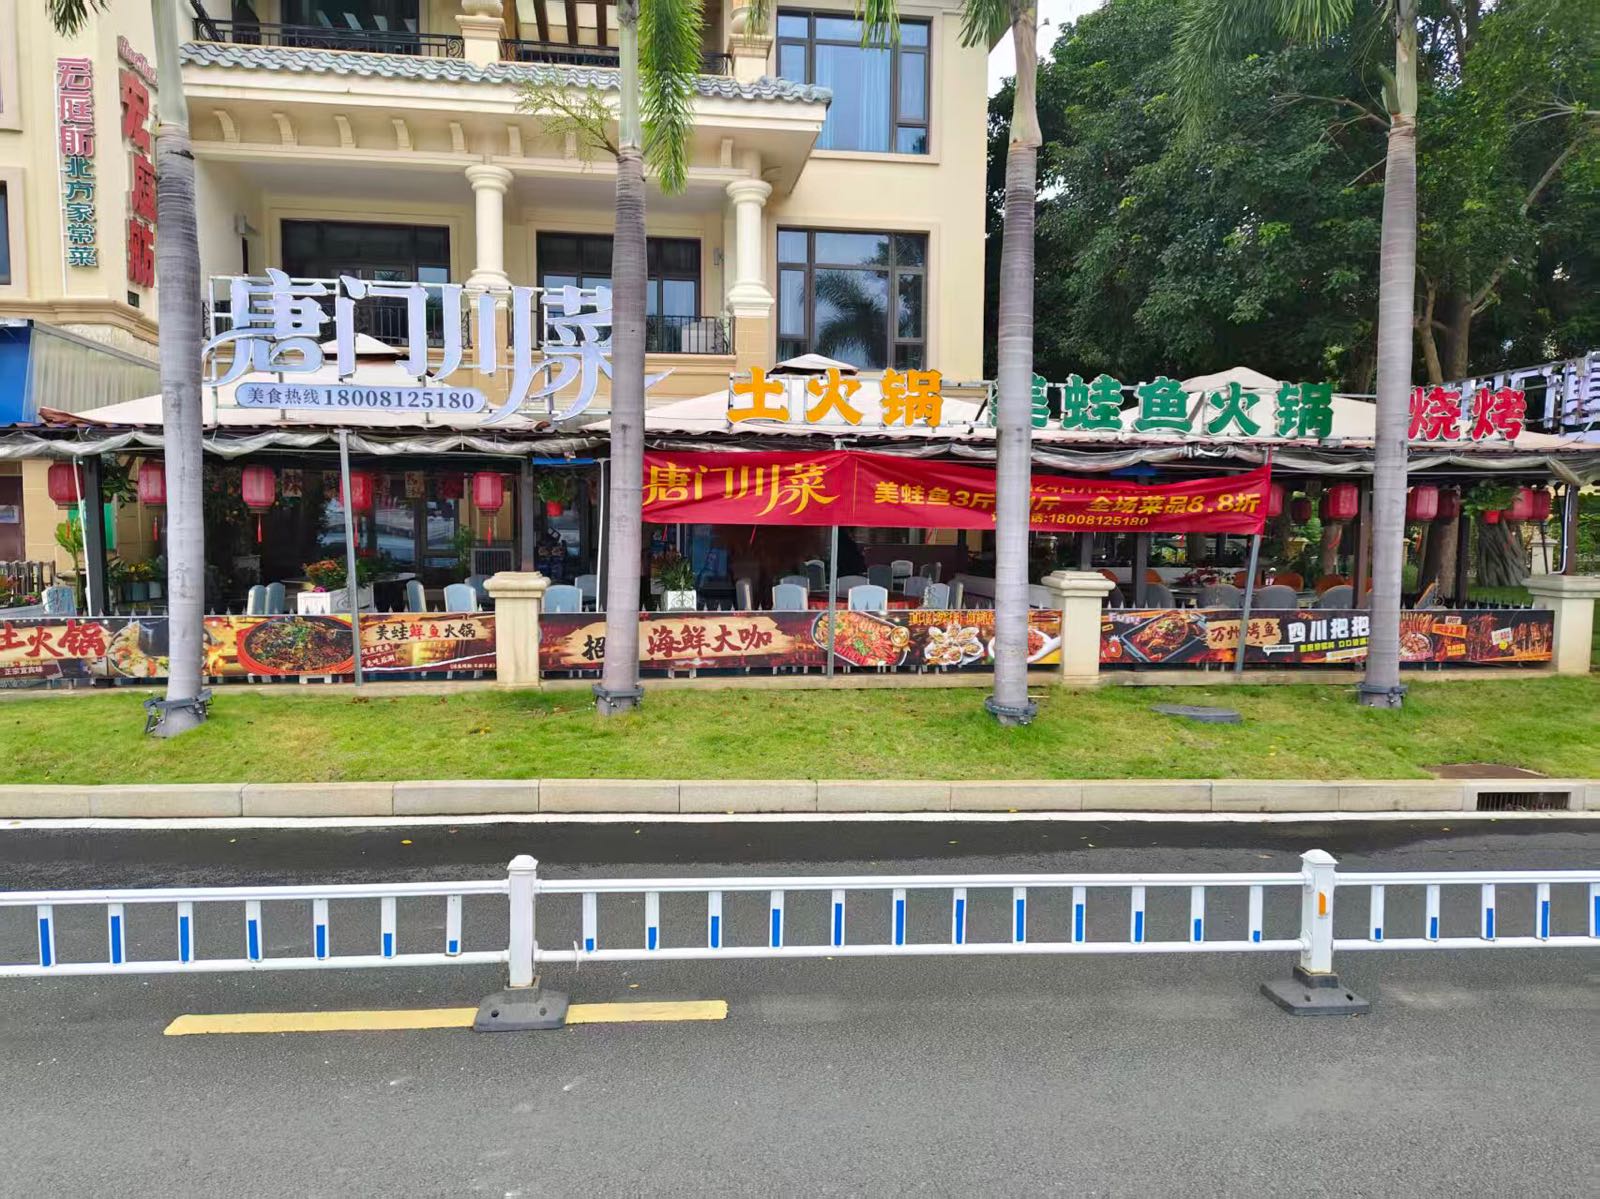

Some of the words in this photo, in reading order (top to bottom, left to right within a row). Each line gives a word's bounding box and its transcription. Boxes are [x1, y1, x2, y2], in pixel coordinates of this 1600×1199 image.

[65, 157, 98, 267] 北方家常菜
[202, 267, 676, 424] 唐门川菜
[726, 366, 944, 428] 土火锅
[1408, 386, 1528, 442] 烧烤
[642, 461, 840, 517] 唐门川菜
[1088, 491, 1262, 515] 全场菜品8.8折
[0, 619, 107, 659] 土火锅
